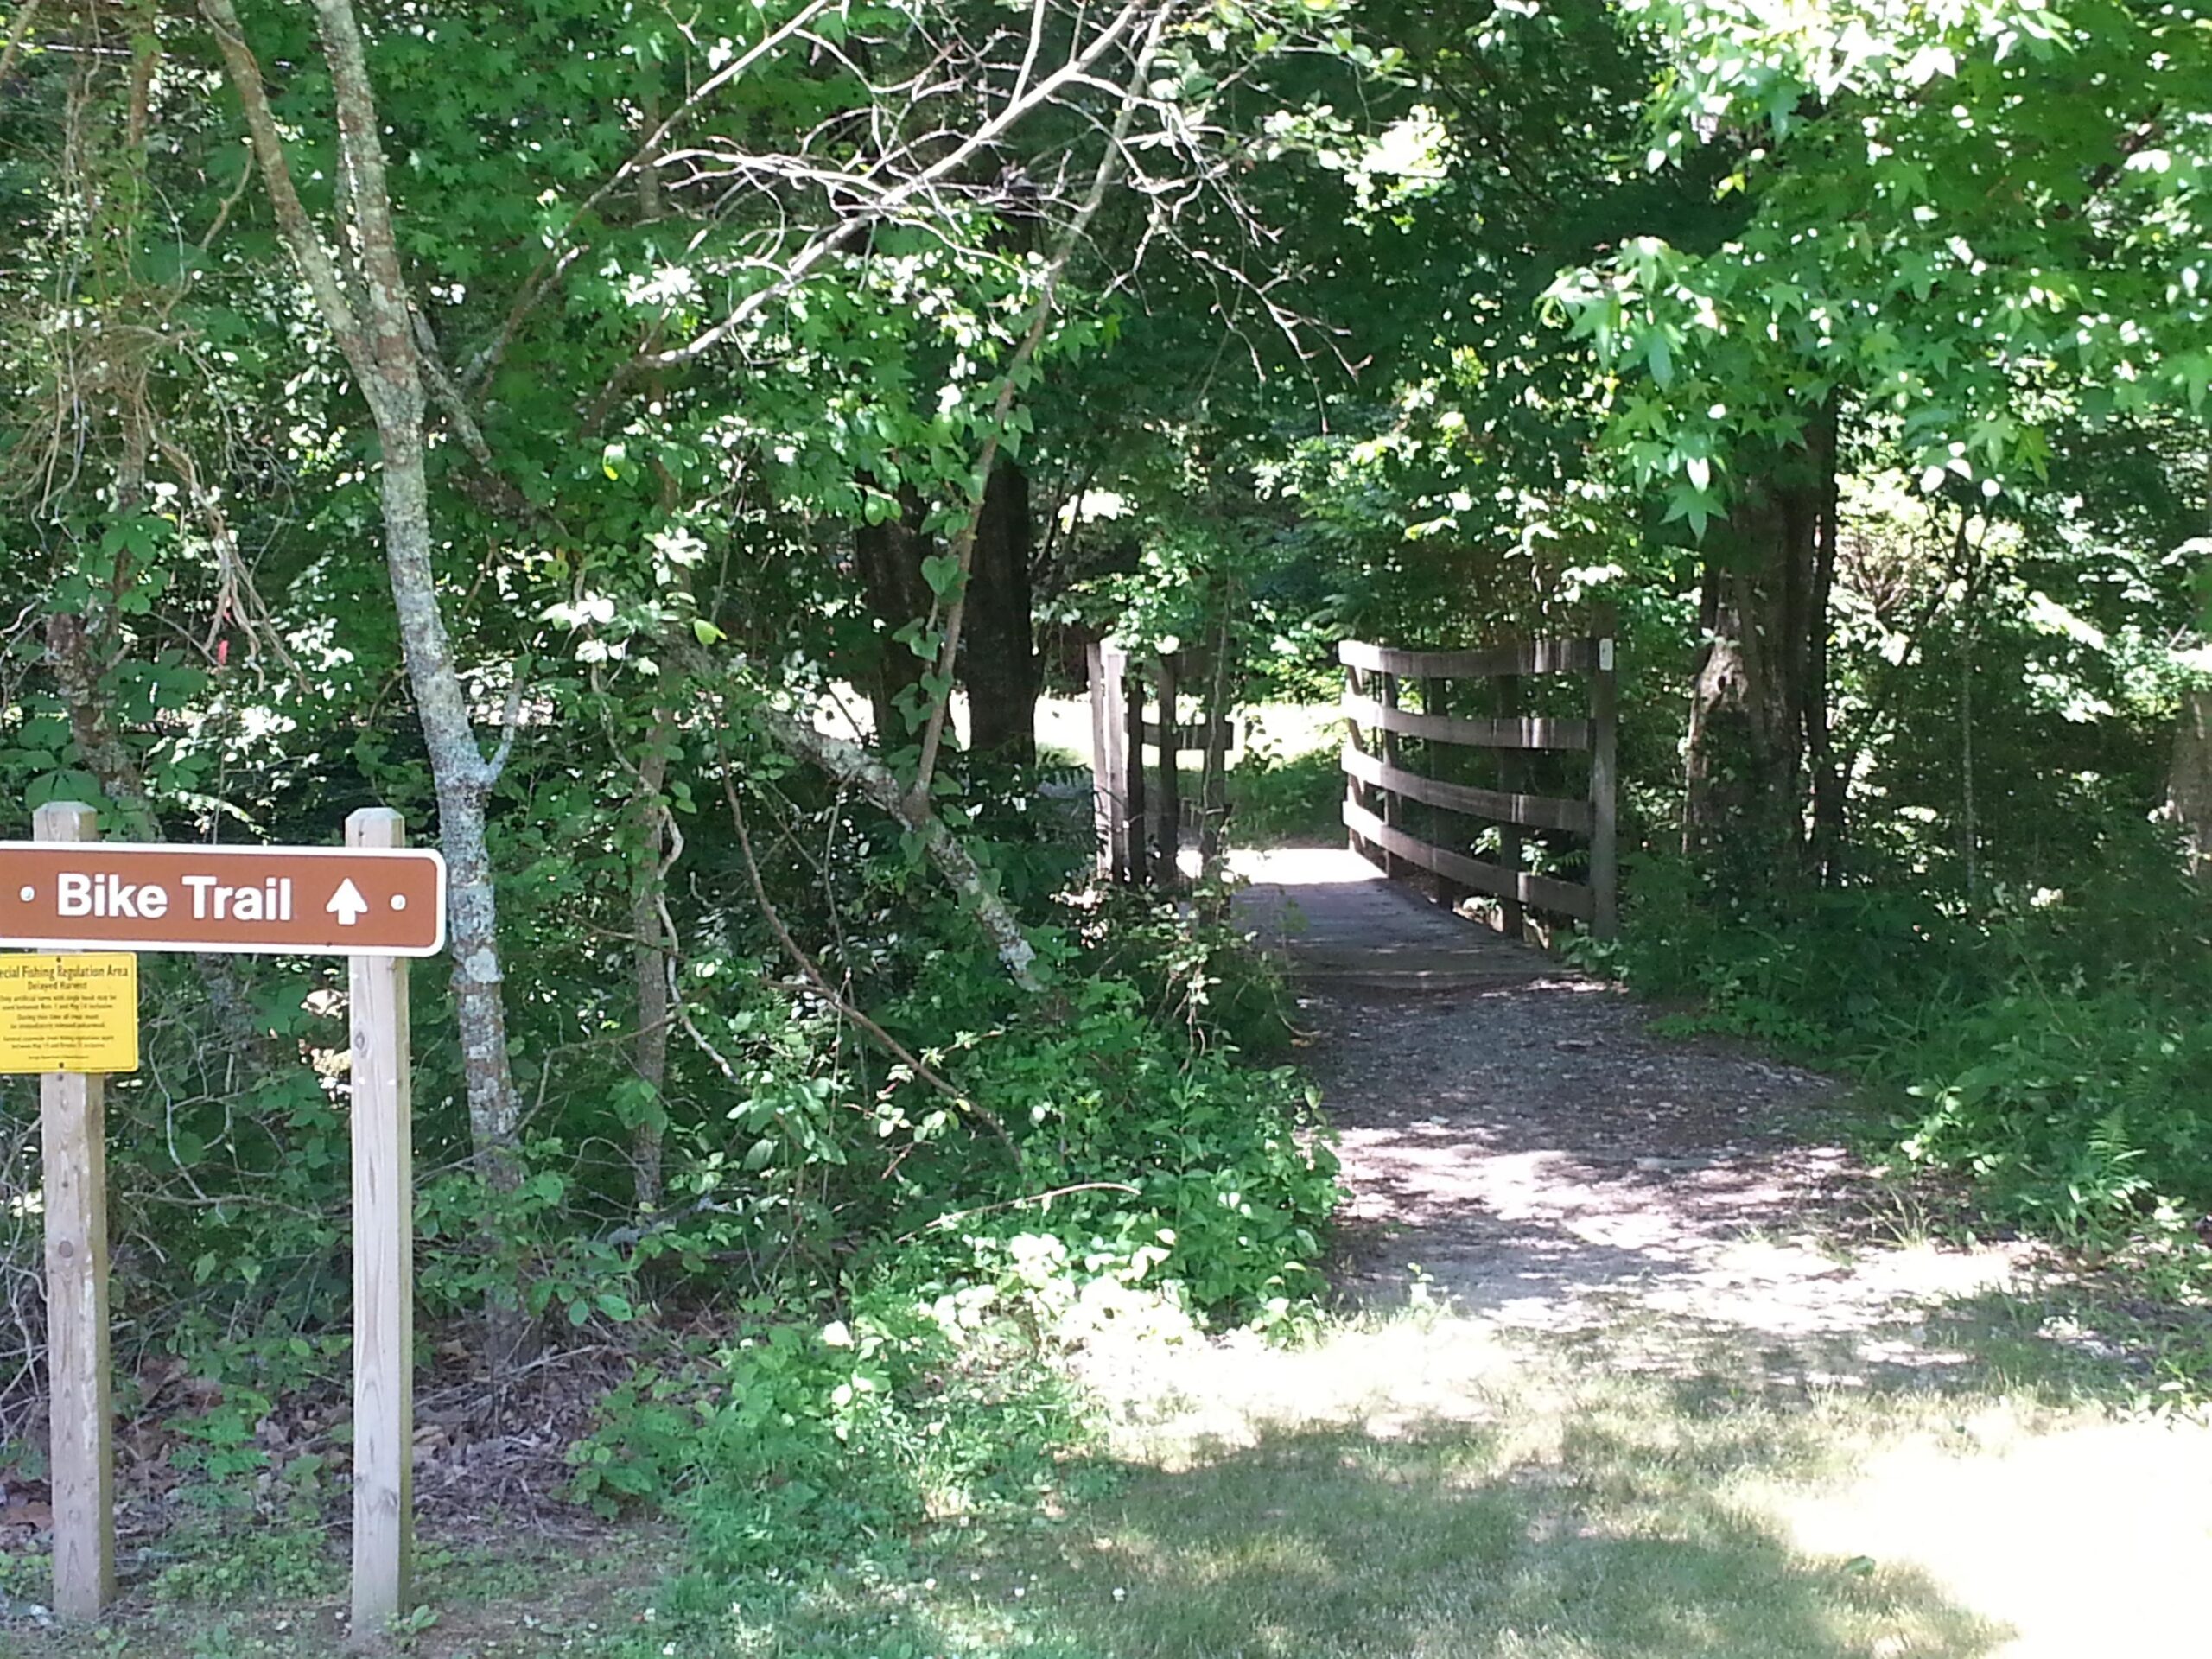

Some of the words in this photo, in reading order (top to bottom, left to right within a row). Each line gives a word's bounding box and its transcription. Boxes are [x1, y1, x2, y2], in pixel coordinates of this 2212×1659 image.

[57, 874, 167, 918] Bike
[182, 875, 291, 921] Trail
[22, 965, 55, 981] Fishing
[57, 965, 104, 981] Regulation
[107, 963, 128, 976] Area
